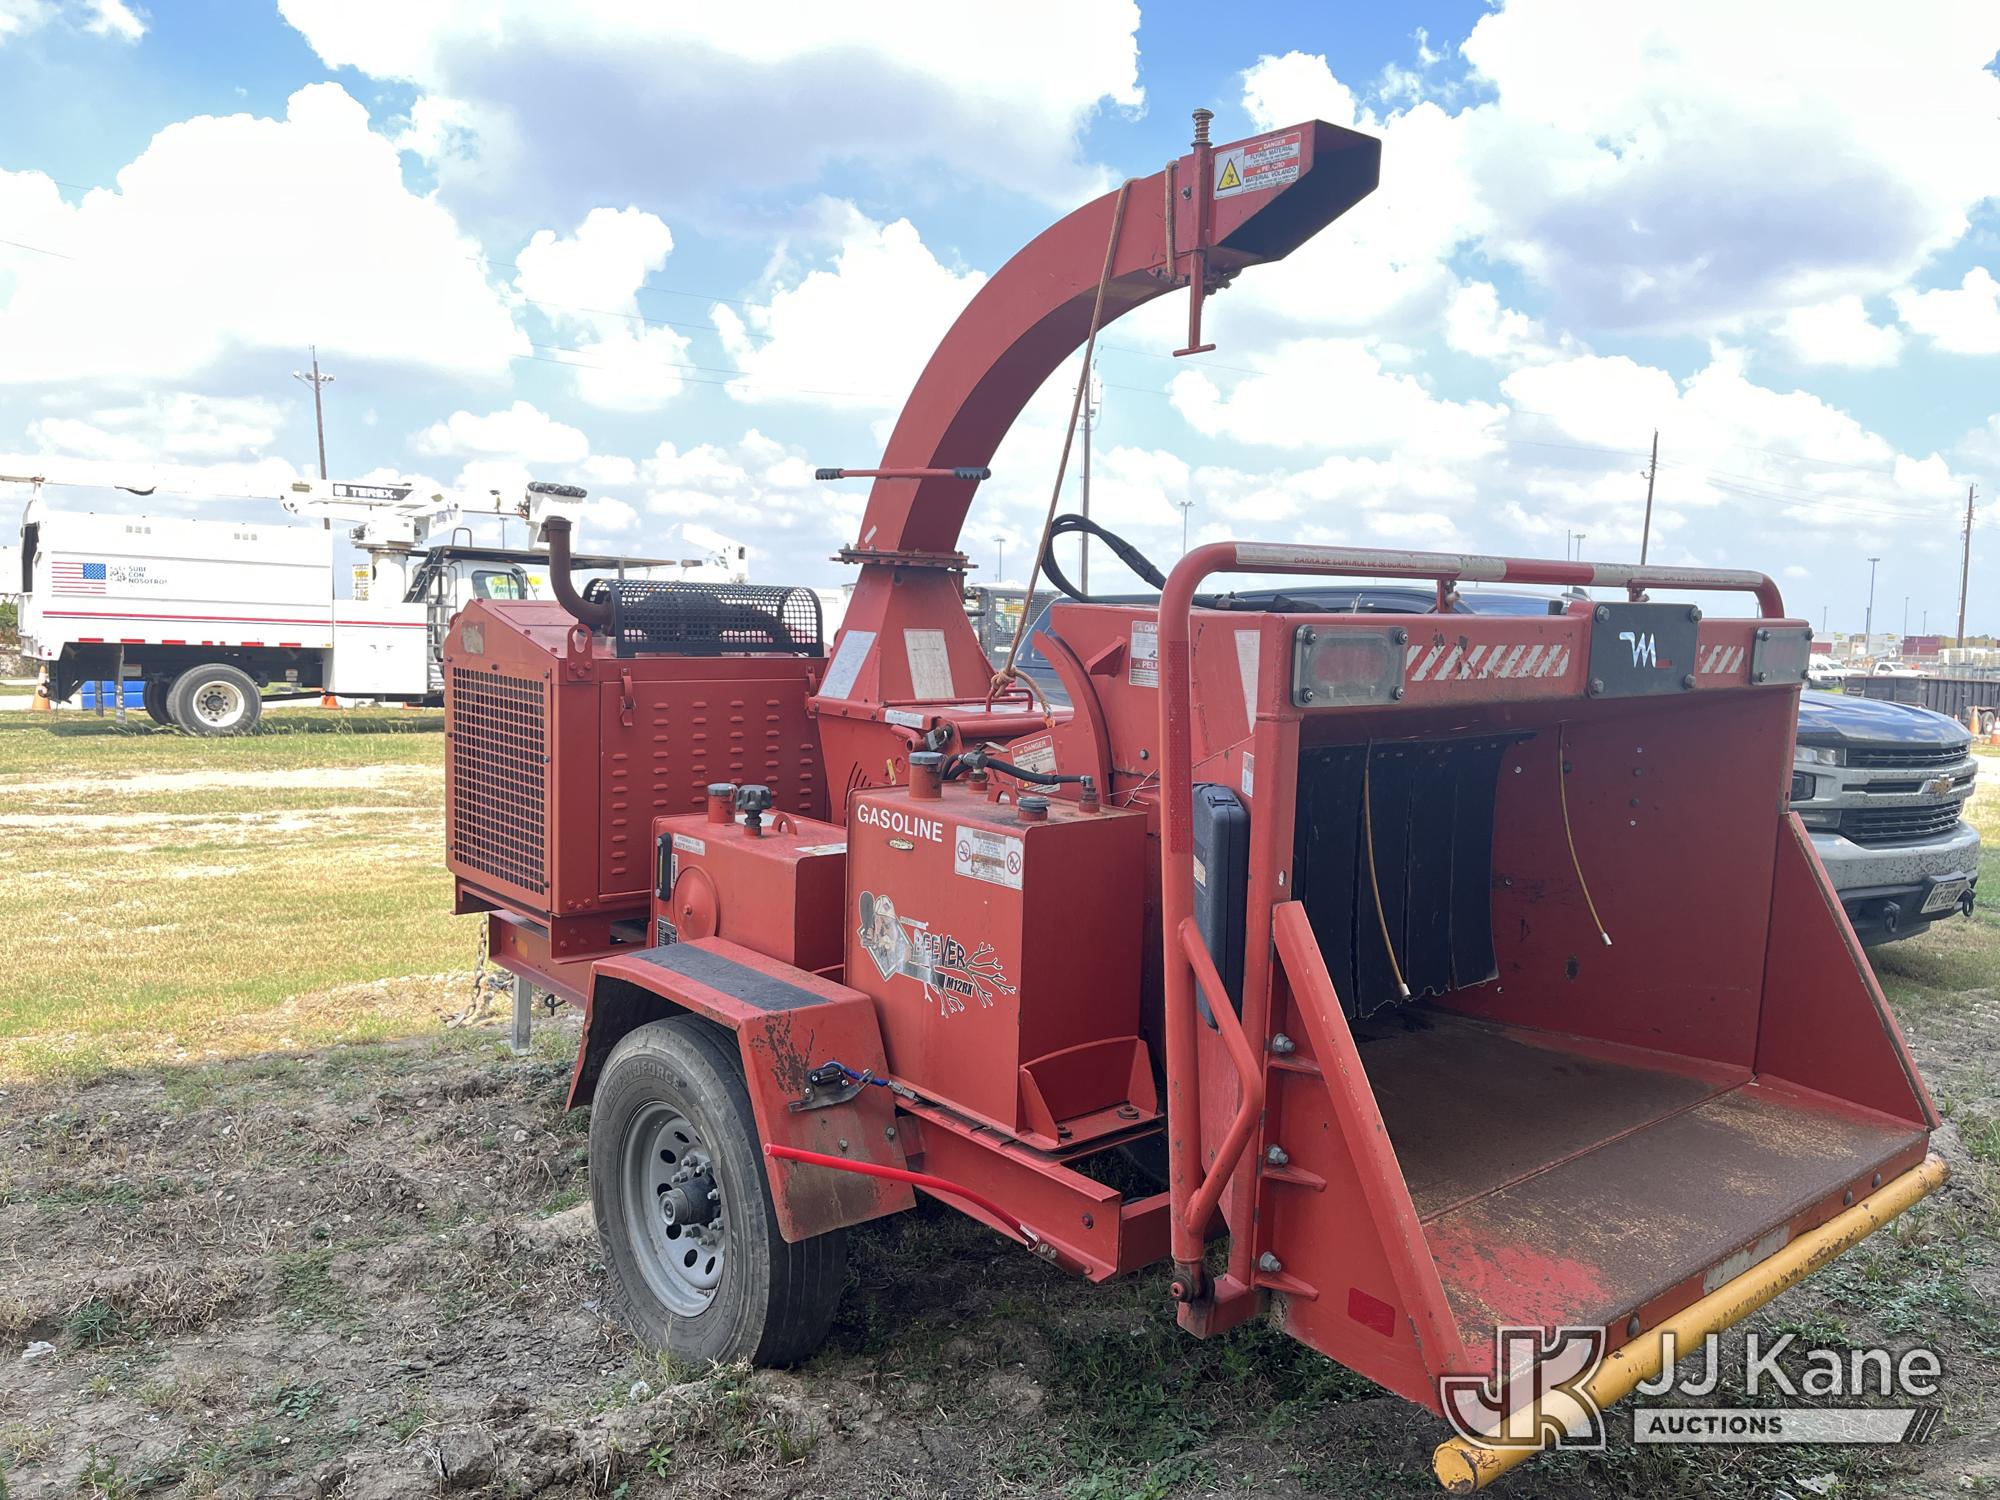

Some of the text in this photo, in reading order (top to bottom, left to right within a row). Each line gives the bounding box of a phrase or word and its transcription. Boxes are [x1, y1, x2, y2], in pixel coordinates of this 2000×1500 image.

[1263, 139, 1286, 149] DANGER
[349, 486, 394, 498] TEREX
[1023, 740, 1046, 753] DANGER
[857, 803, 943, 843] GASOLINE
[913, 929, 966, 968] BEEVER
[946, 976, 973, 996] M12RX
